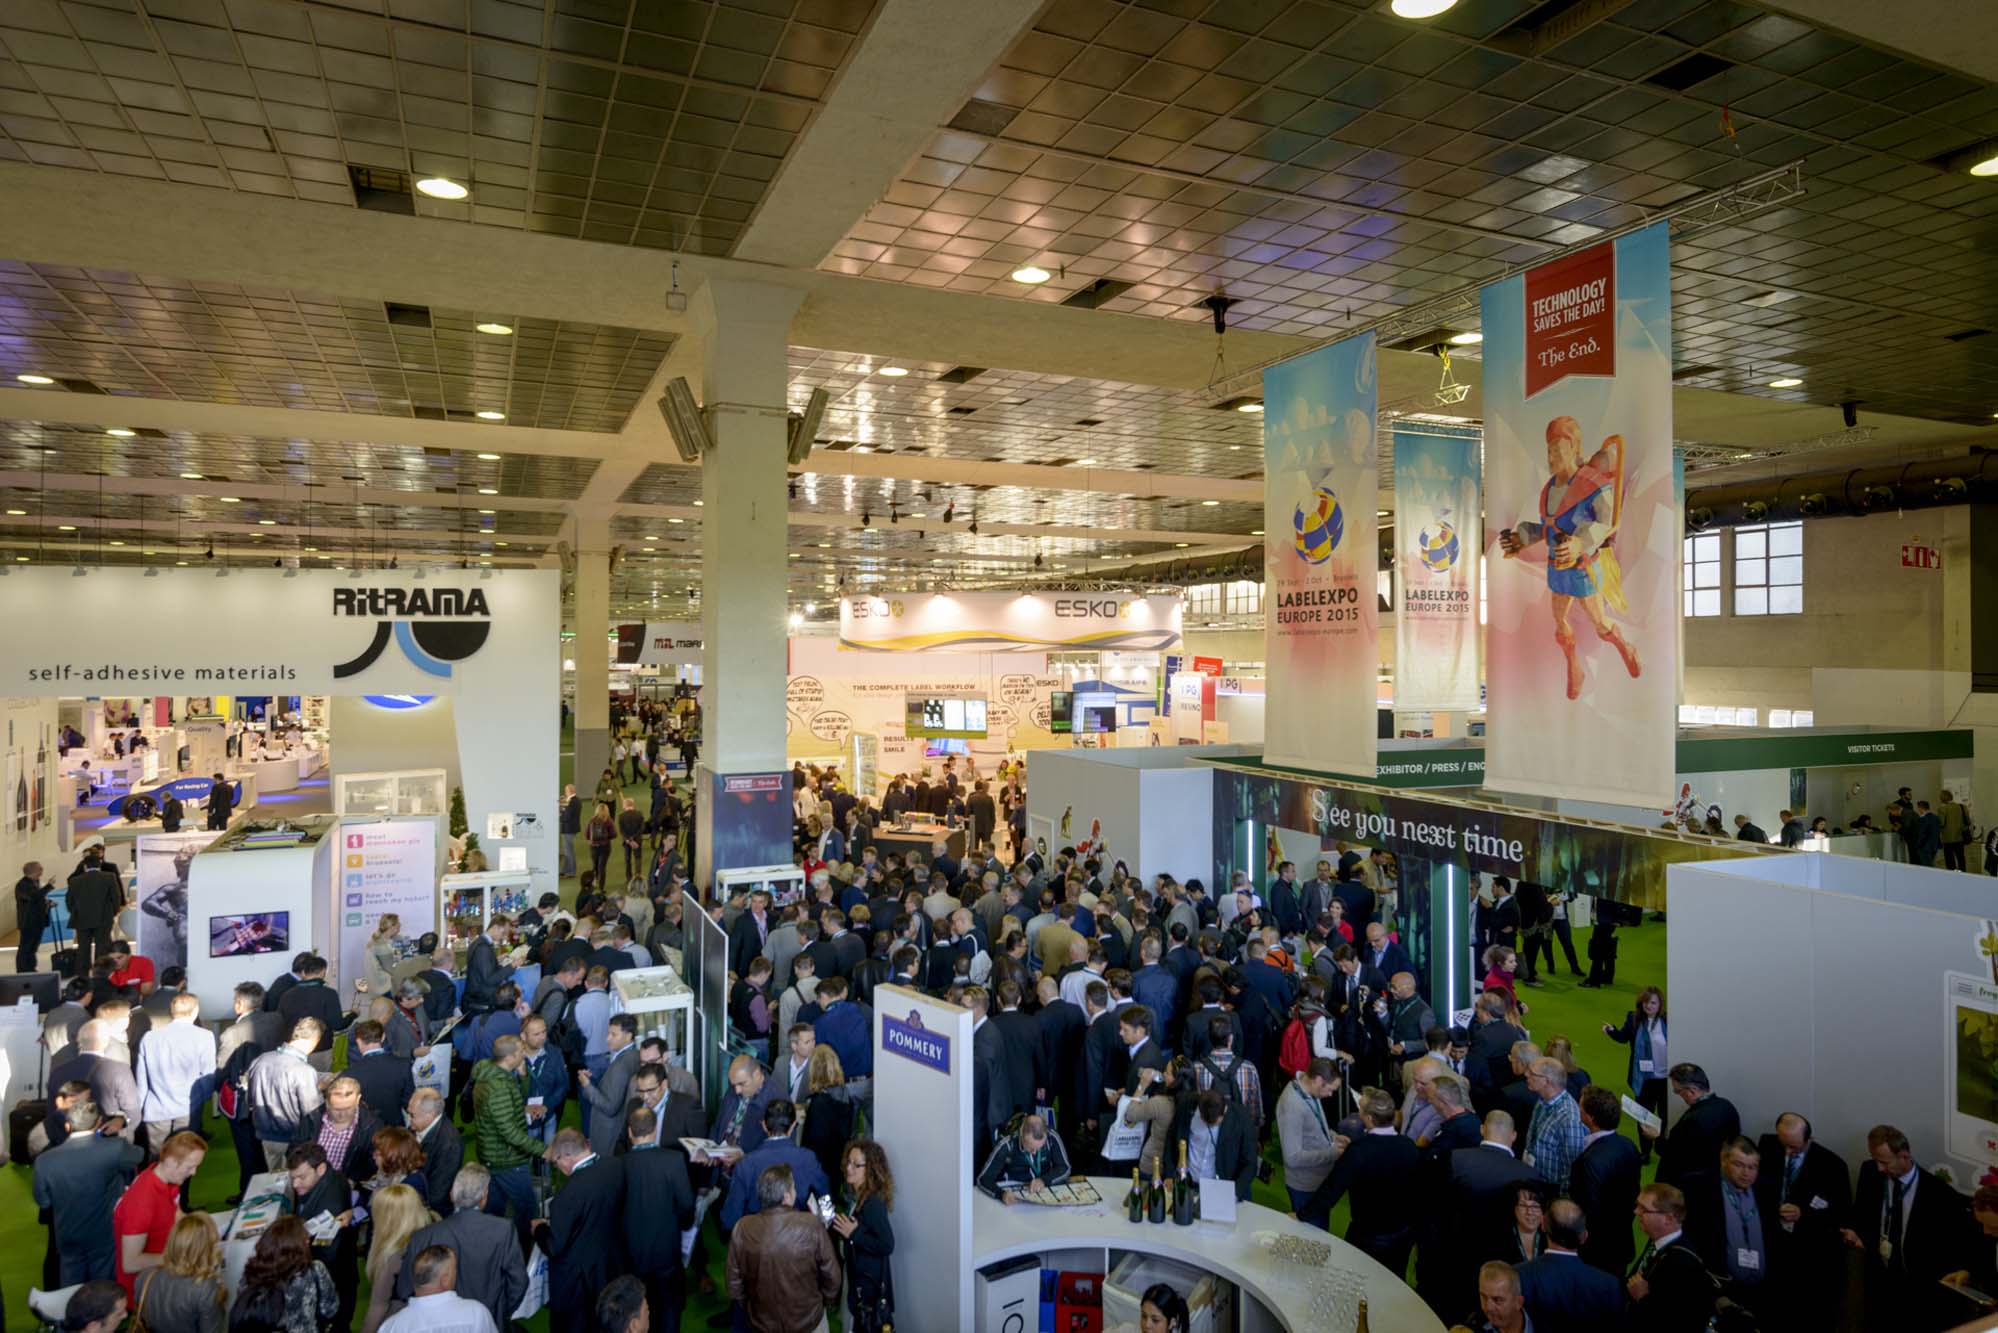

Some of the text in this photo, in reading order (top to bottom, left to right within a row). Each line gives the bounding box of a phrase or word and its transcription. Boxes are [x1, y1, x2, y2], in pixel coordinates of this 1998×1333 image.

[1532, 277, 1606, 318] TECHNOLOGY
[1533, 298, 1606, 334] SAVES THE DAY!
[1538, 336, 1601, 368] The End.
[1277, 587, 1358, 608] LABELEXPO
[1405, 589, 1469, 602] LABELEXPO
[853, 601, 890, 618] ESKO
[1055, 600, 1118, 618] ESKO
[1277, 607, 1359, 623] EUROPE 2015
[1405, 602, 1469, 613] EUROPE 2015
[29, 664, 297, 682] self-adhesive materials
[852, 684, 868, 692] THE
[870, 684, 908, 692] COMPLETE
[1847, 743, 1896, 754] VISITOR TICKETS
[1375, 763, 1423, 776] EXHIBITOR
[1432, 761, 1460, 773] PRESS
[1311, 788, 1525, 863] See you next time
[889, 1028, 943, 1061] POMMERY
